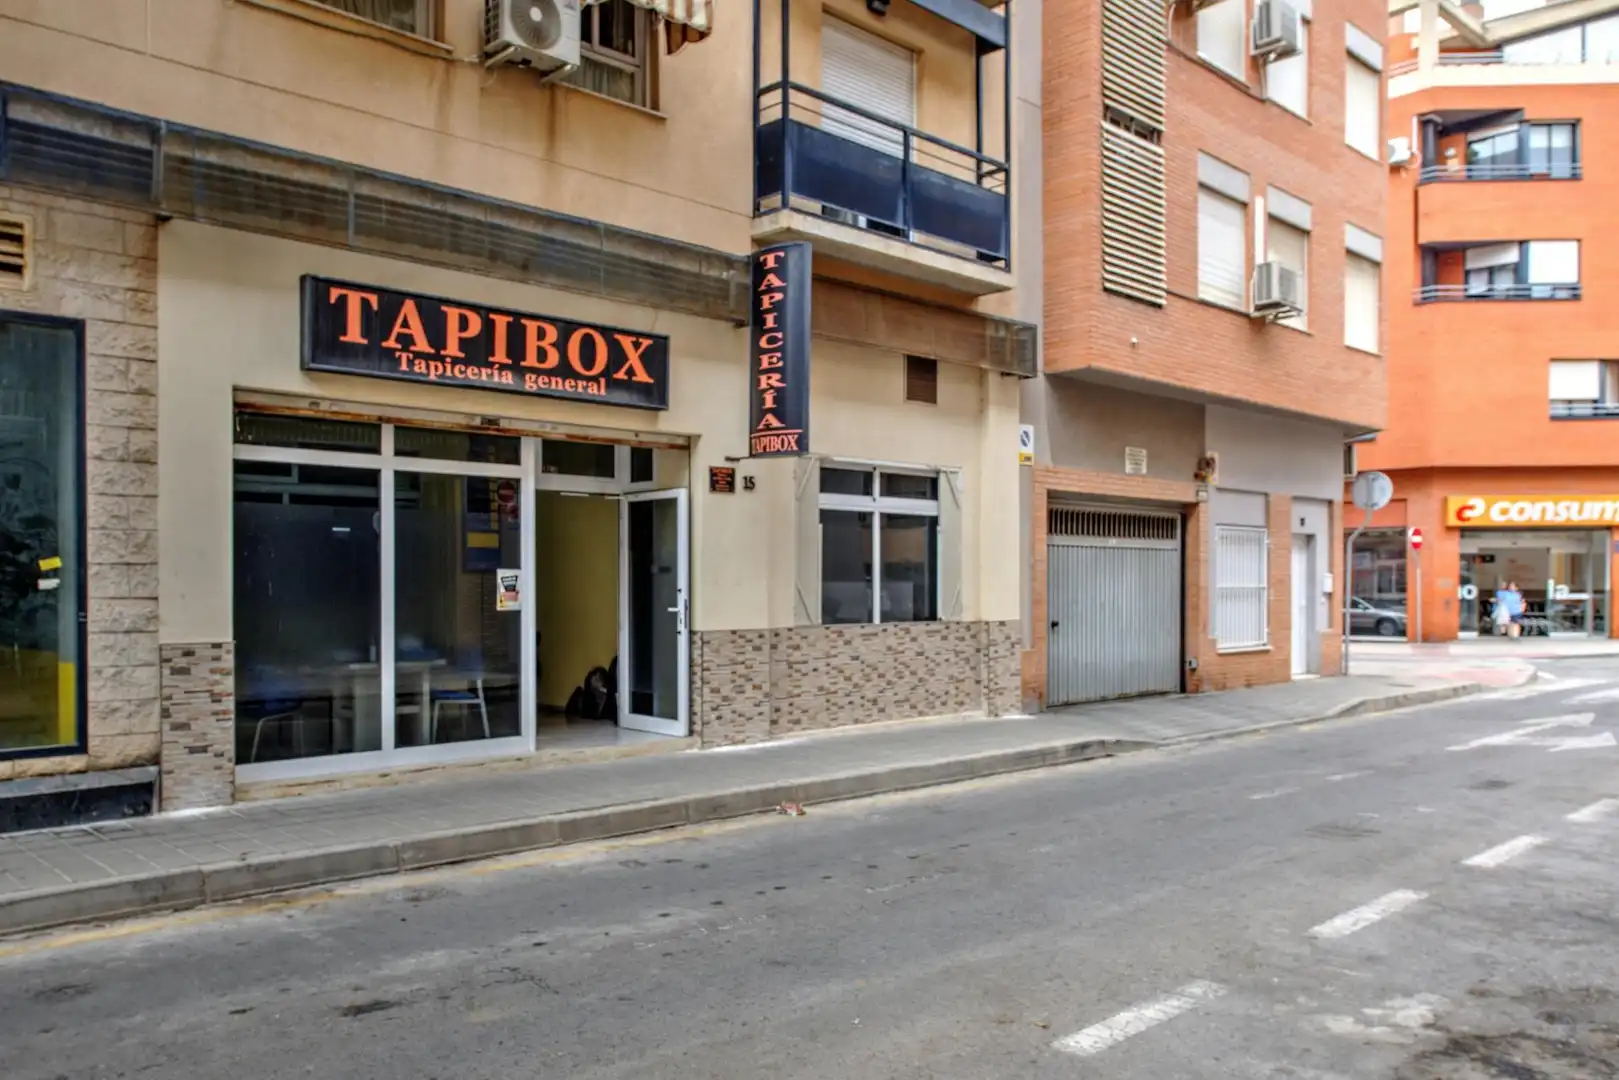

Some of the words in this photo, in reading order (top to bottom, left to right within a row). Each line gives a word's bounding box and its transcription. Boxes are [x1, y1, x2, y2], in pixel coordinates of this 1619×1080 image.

[329, 285, 655, 384] TAPIBOX
[758, 251, 787, 429] TAPICERÍA
[395, 350, 514, 386] Tapicería
[524, 371, 607, 396] general
[742, 475, 756, 491] 15
